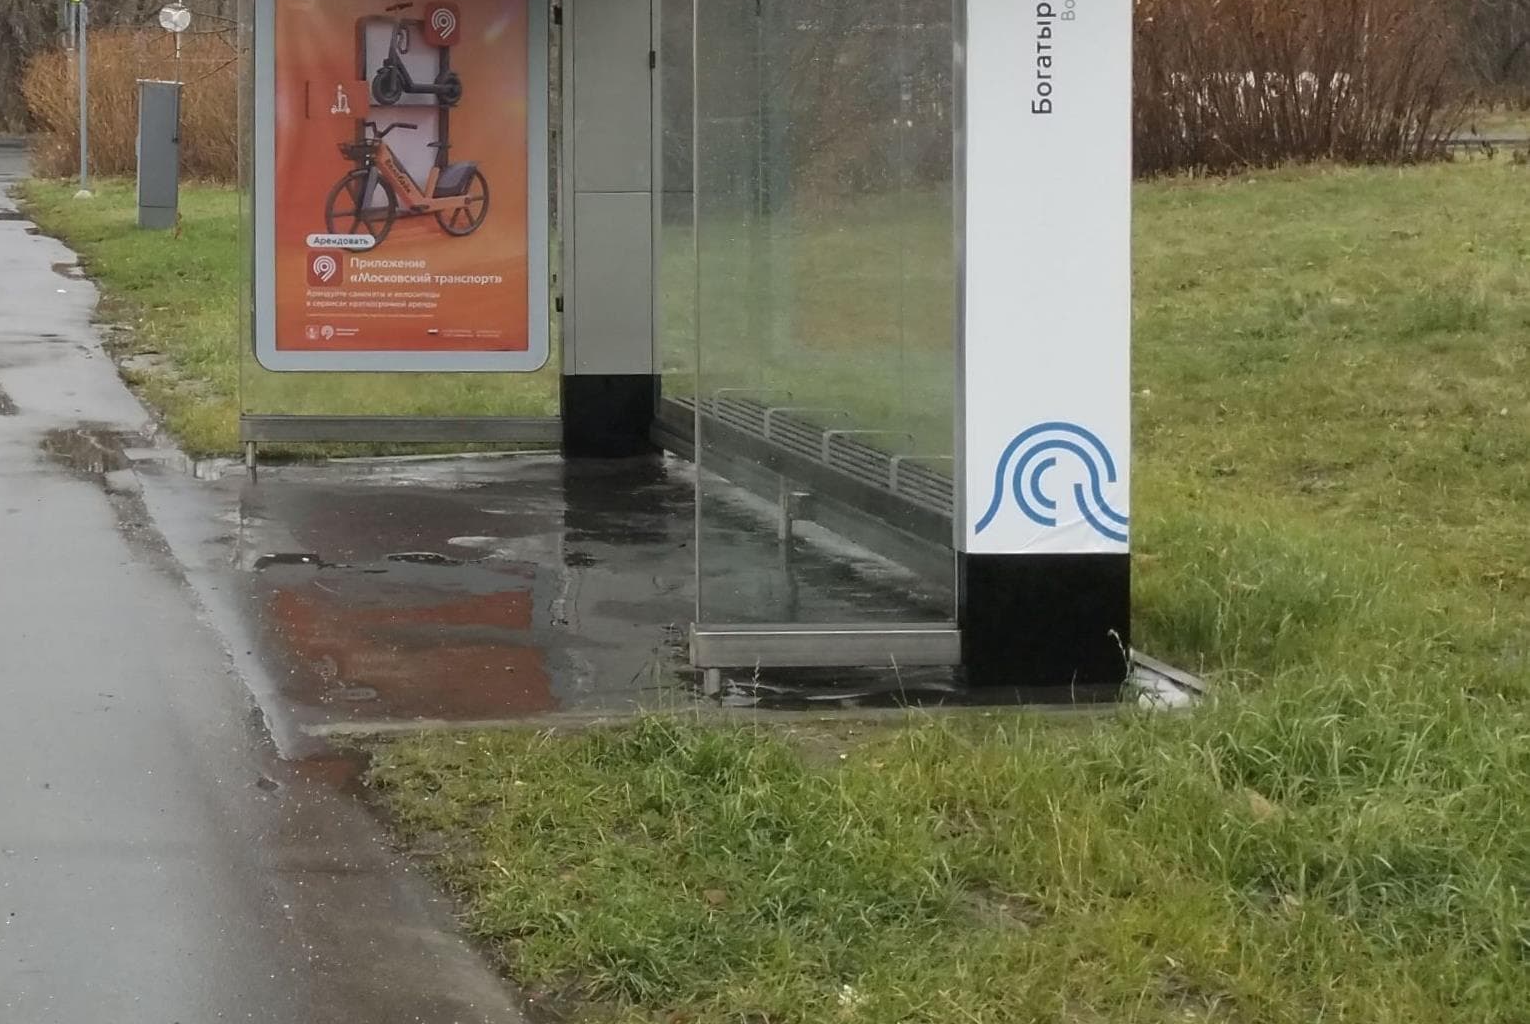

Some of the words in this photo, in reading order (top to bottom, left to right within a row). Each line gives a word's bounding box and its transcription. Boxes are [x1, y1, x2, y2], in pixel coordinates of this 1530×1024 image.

[313, 236, 370, 246] Арендовать
[350, 257, 427, 270] Приложение
[350, 272, 432, 284] «Московский
[434, 275, 503, 286] транспорт»
